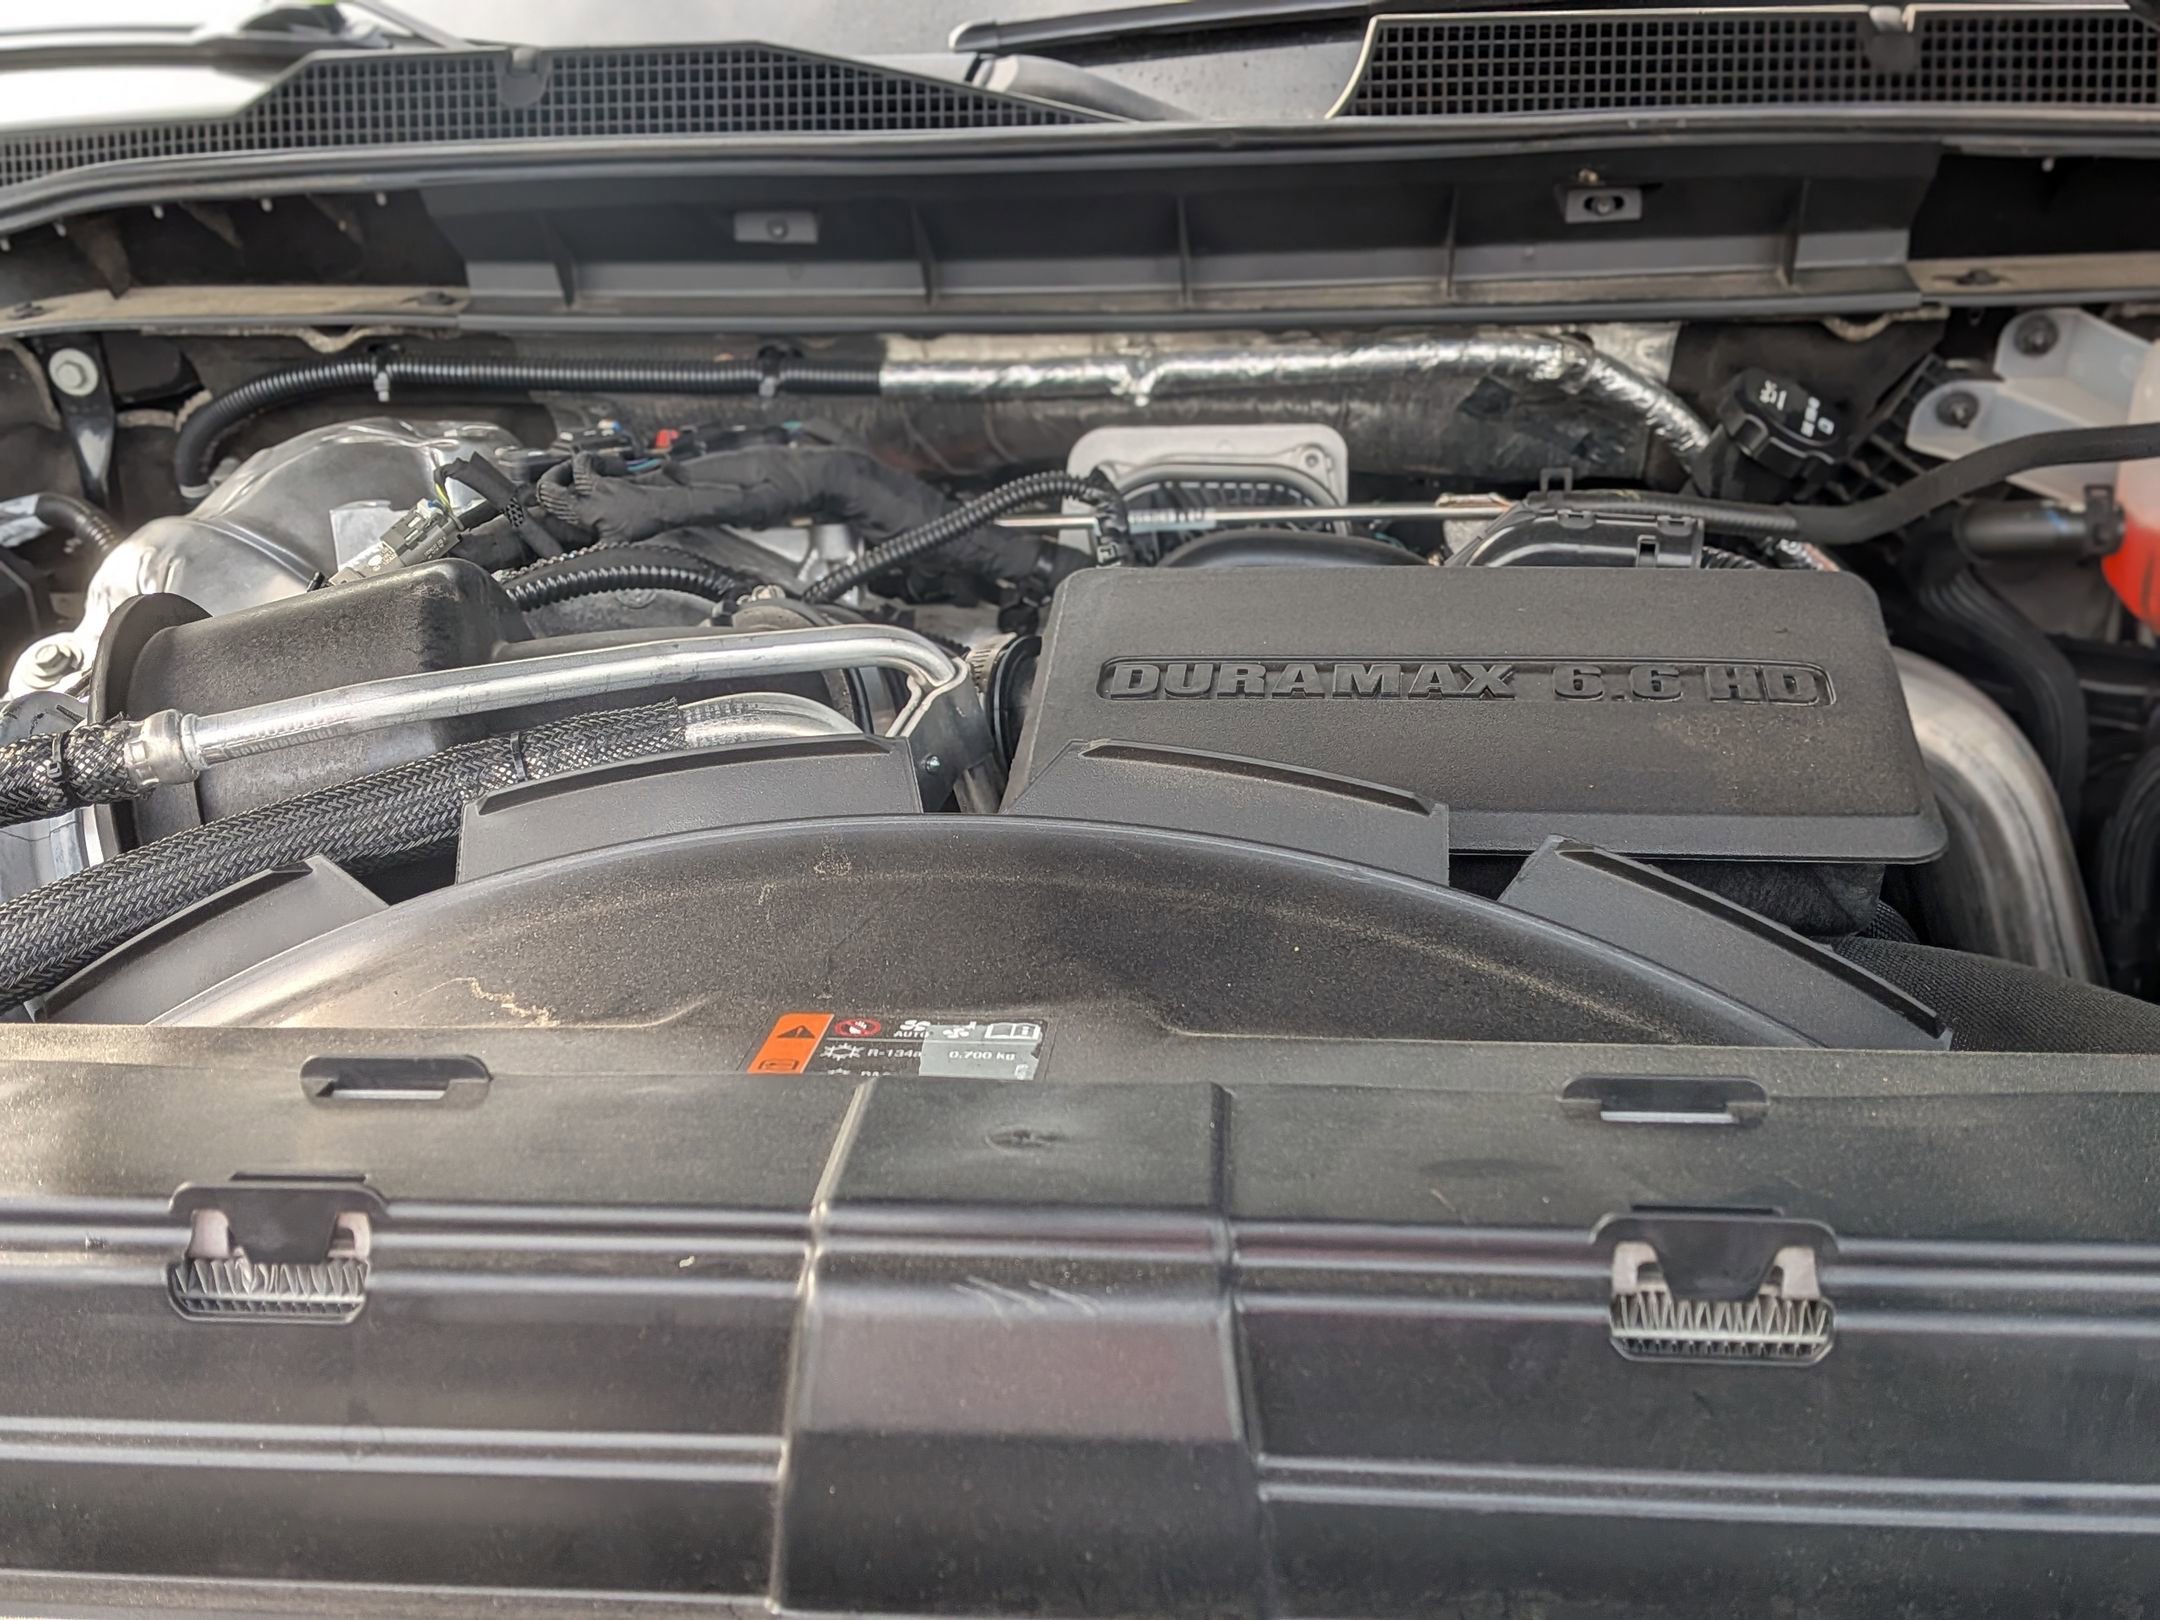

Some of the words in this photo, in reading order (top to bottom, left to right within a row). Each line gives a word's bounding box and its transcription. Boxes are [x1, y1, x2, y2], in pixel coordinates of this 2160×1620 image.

[1111, 663, 1515, 700] DURAMAX
[1553, 664, 1682, 702] 6.6
[1703, 665, 1819, 706] HD
[893, 1030, 930, 1039] AUTO
[948, 1051, 993, 1060] 0.700
